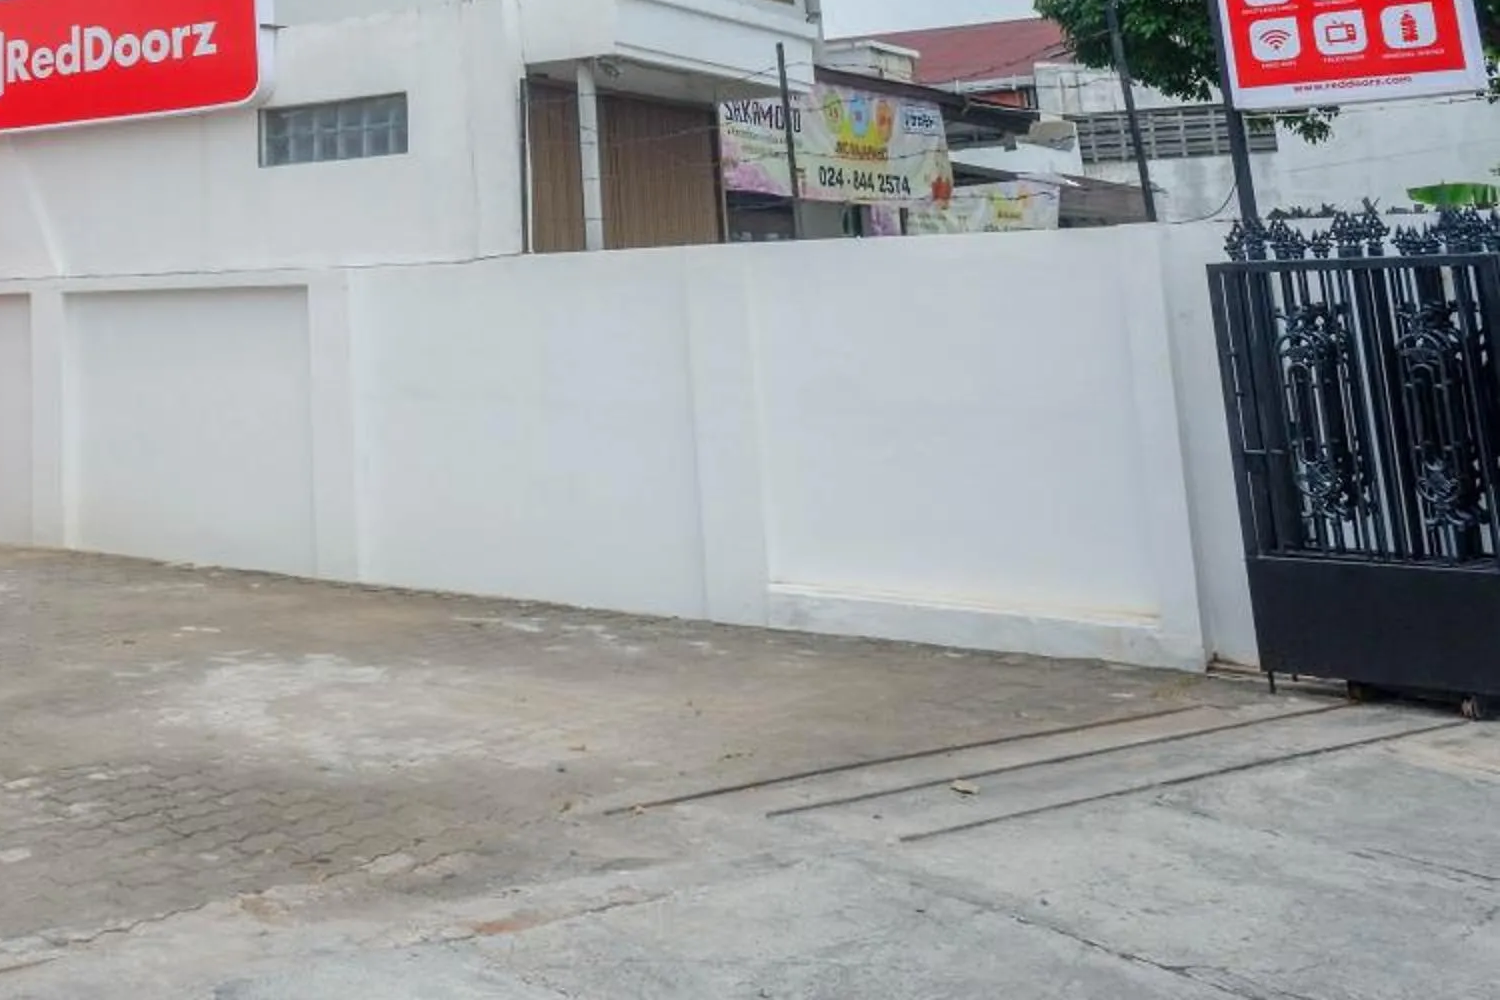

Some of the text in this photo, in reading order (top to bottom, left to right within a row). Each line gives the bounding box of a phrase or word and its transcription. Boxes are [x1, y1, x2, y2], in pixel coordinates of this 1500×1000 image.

[6, 21, 217, 83] RedDoorz
[724, 100, 801, 133] SAKAMOO
[818, 166, 844, 187] 024
[853, 169, 875, 192] 844
[878, 173, 911, 195] 2574
